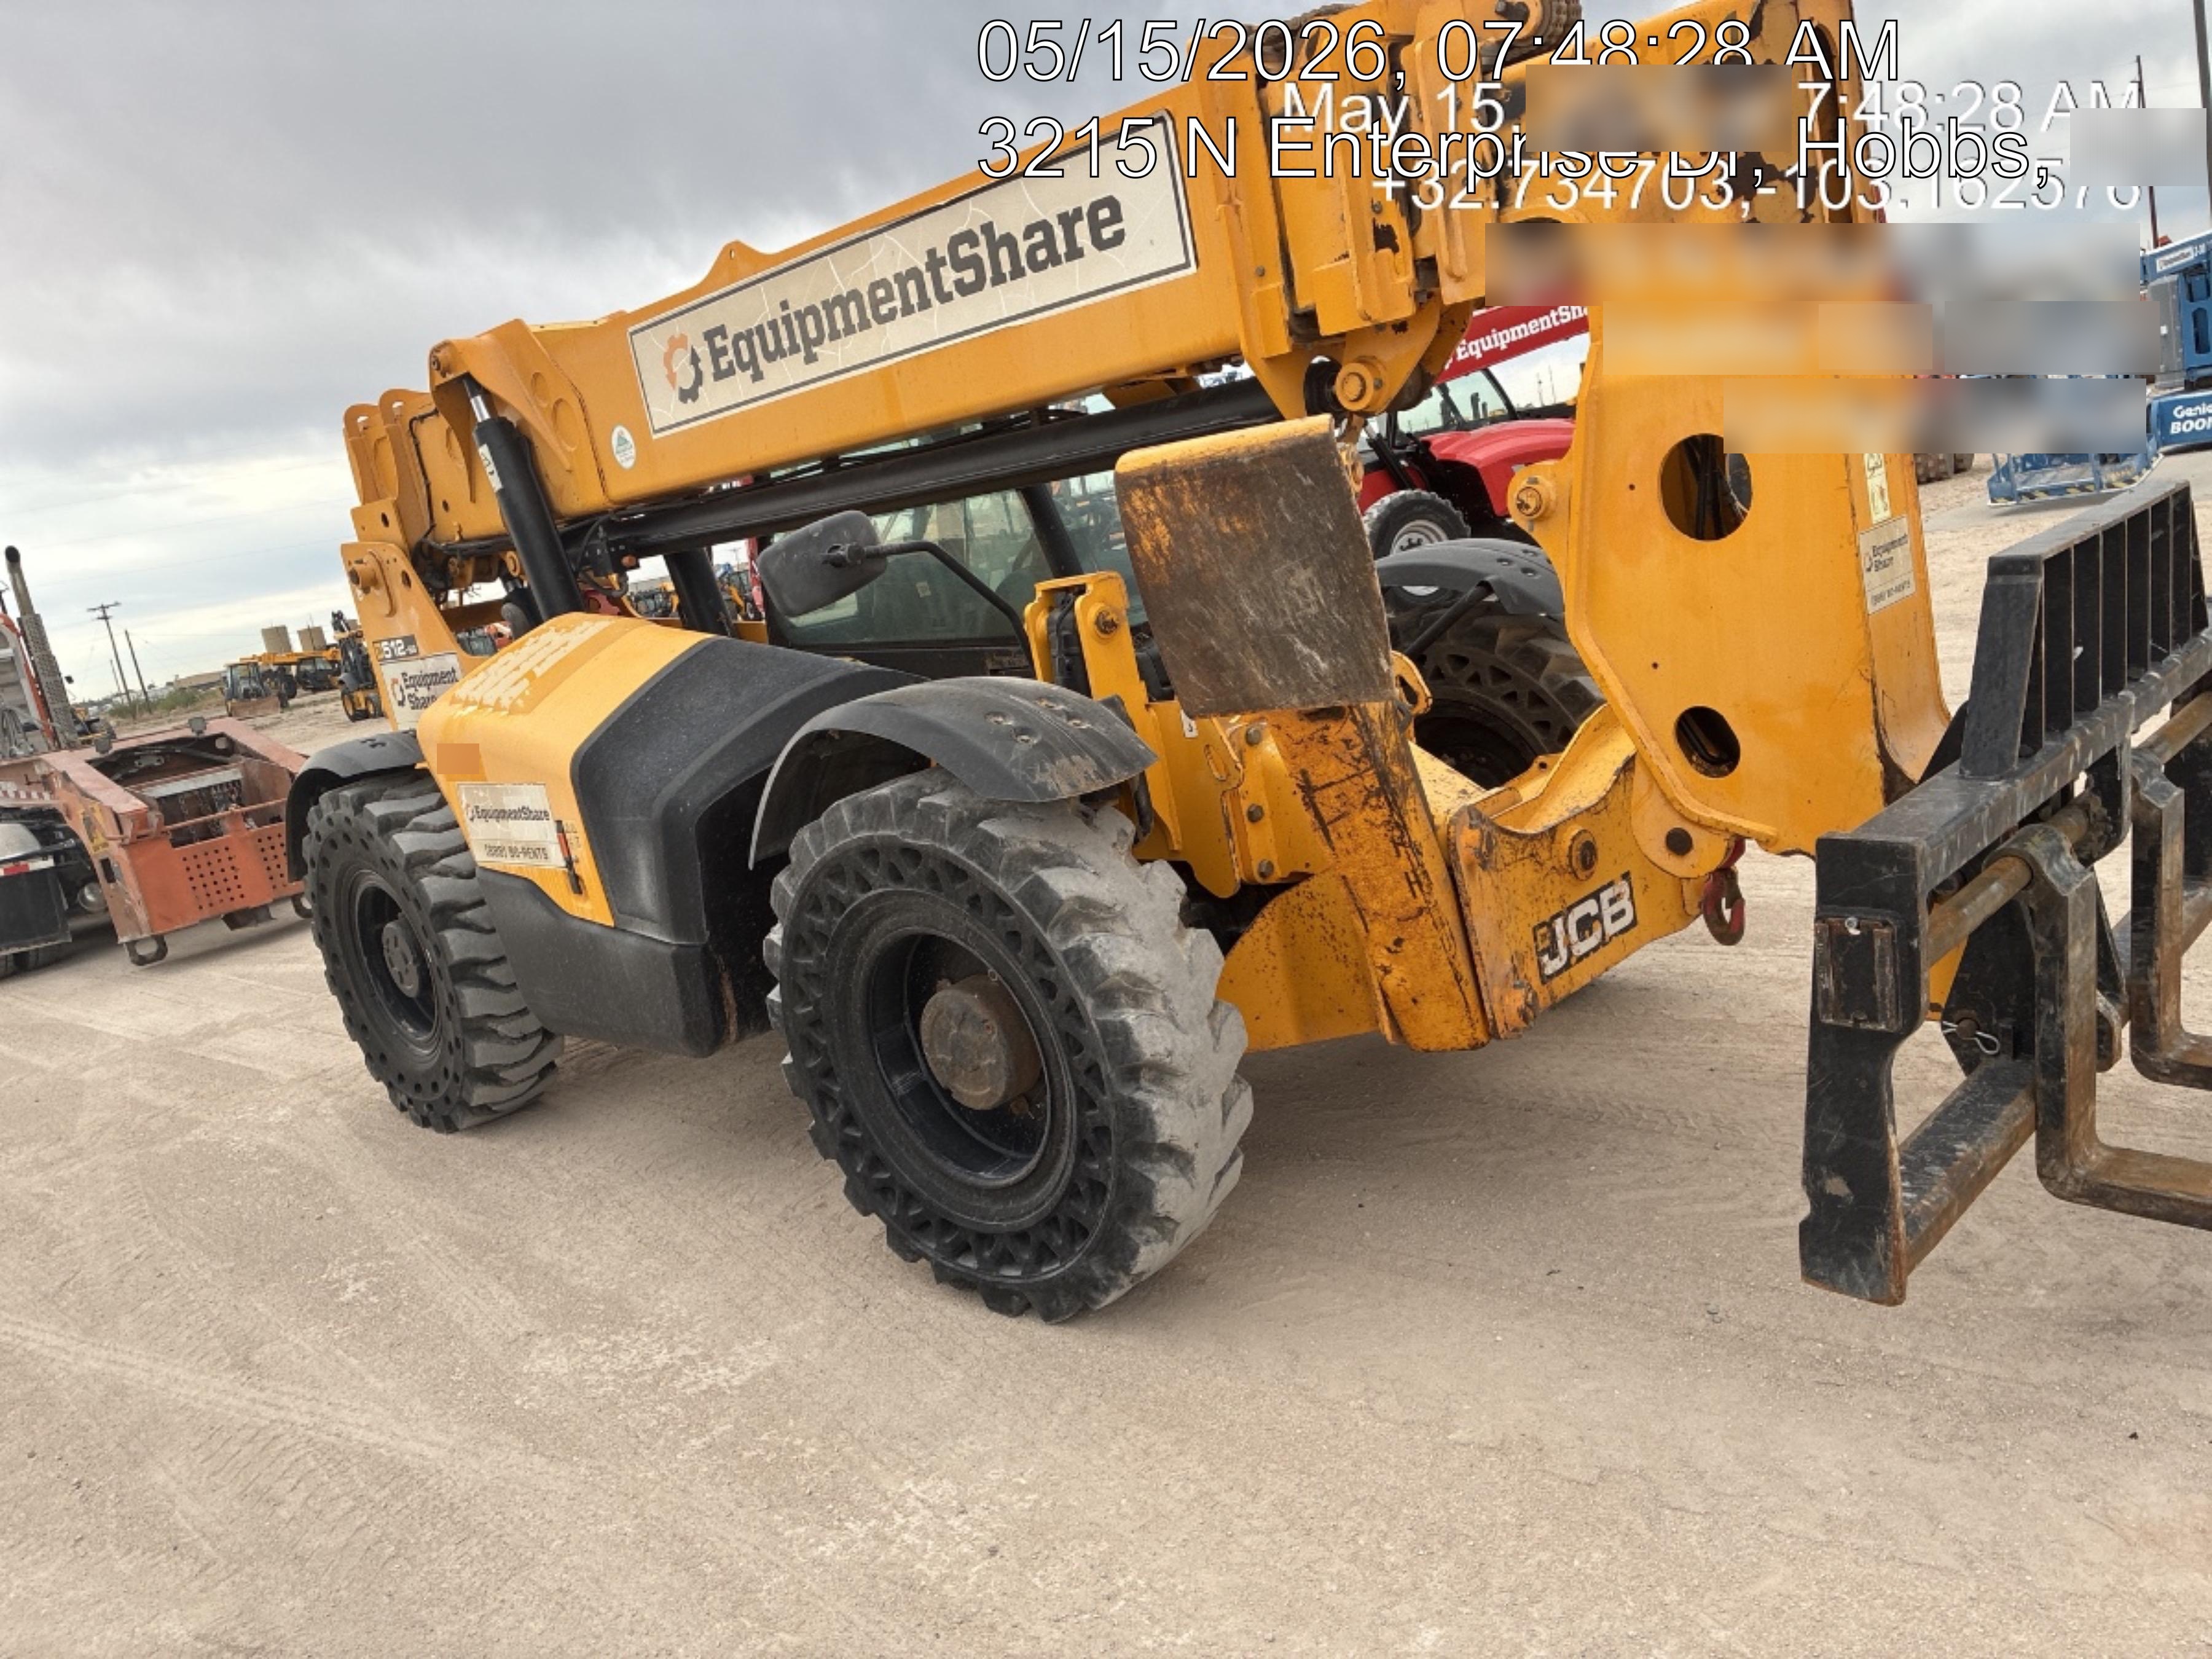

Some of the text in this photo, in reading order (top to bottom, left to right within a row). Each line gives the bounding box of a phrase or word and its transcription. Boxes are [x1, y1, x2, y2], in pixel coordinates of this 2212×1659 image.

[704, 194, 1126, 384] EquipmentShare
[1456, 306, 1588, 361] EquipmentSh
[401, 666, 459, 691] Equipment
[474, 805, 550, 823] EquipmentShare
[1537, 880, 1635, 976] JCB
